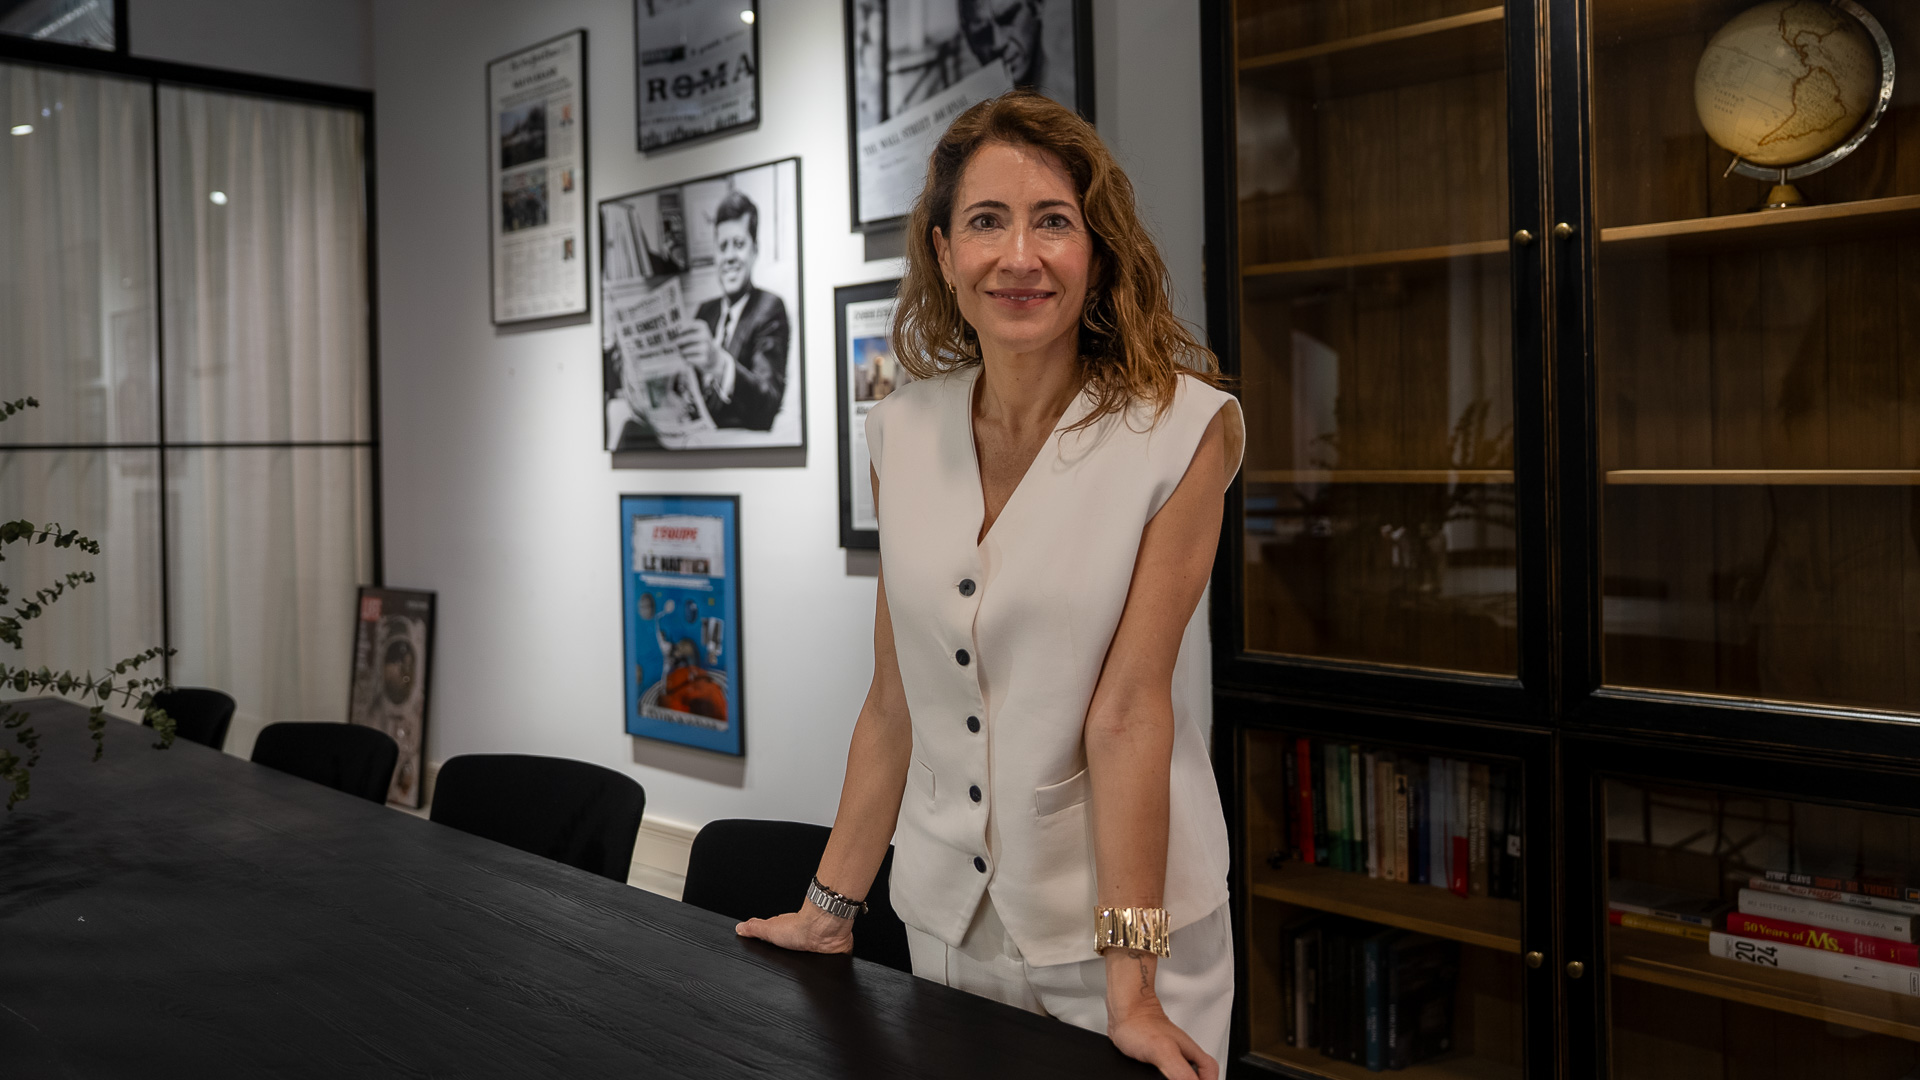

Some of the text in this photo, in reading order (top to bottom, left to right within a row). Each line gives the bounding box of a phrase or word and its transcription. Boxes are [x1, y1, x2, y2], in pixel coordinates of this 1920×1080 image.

[647, 53, 754, 102] ROMA
[1759, 902, 1797, 915] HISTORIA
[1808, 911, 1849, 924] MICHELLE
[1854, 918, 1887, 931] OBAMA
[1735, 941, 1755, 962] 20
[1743, 921, 1758, 934] 50
[1759, 924, 1790, 939] Years
[1792, 931, 1804, 942] of
[1805, 929, 1844, 953] Ms.
[1757, 947, 1777, 966] 24
